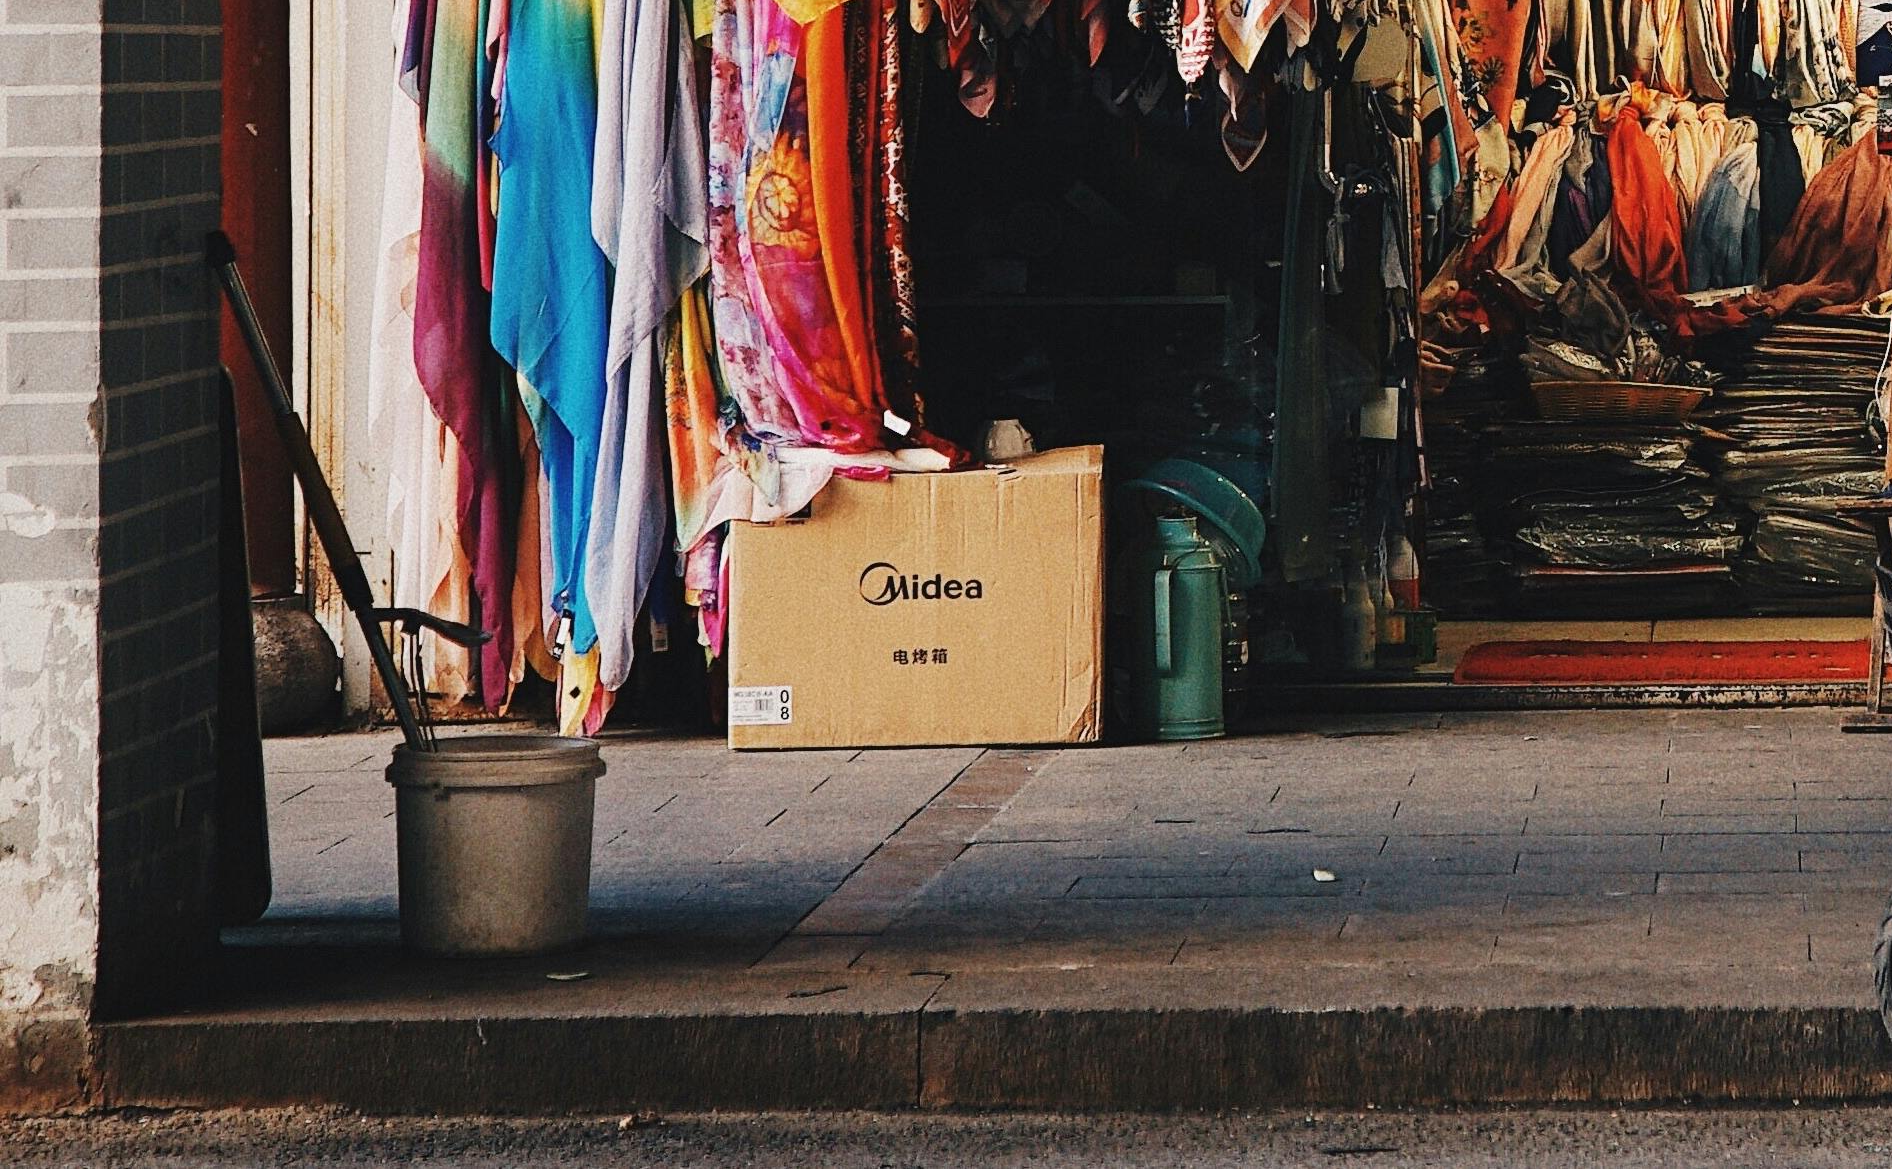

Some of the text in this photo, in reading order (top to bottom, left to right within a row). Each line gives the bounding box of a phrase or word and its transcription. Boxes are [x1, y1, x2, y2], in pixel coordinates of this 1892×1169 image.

[859, 562, 983, 606] Midea
[893, 648, 948, 665] 电烤箱
